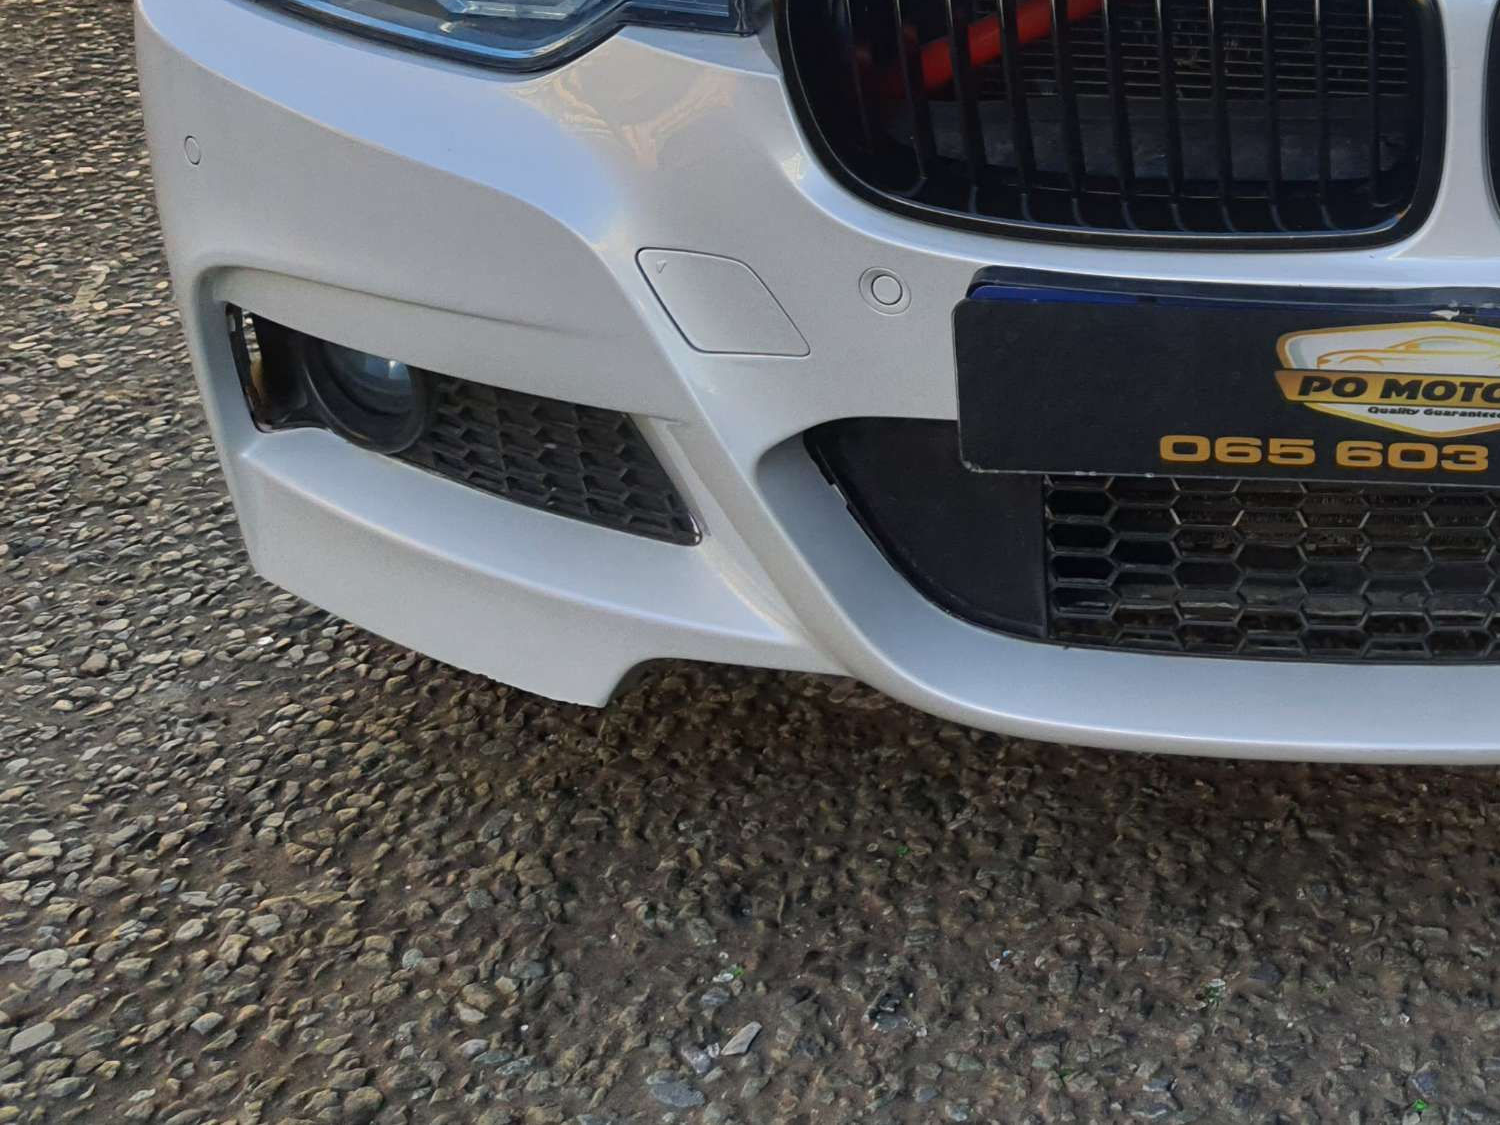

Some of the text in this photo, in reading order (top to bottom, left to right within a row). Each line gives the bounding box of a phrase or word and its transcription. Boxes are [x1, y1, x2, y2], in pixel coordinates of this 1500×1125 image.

[1297, 375, 1368, 399] PO
[1367, 405, 1420, 417] Quality
[1159, 434, 1315, 466] 065
[1335, 439, 1489, 472] 603
